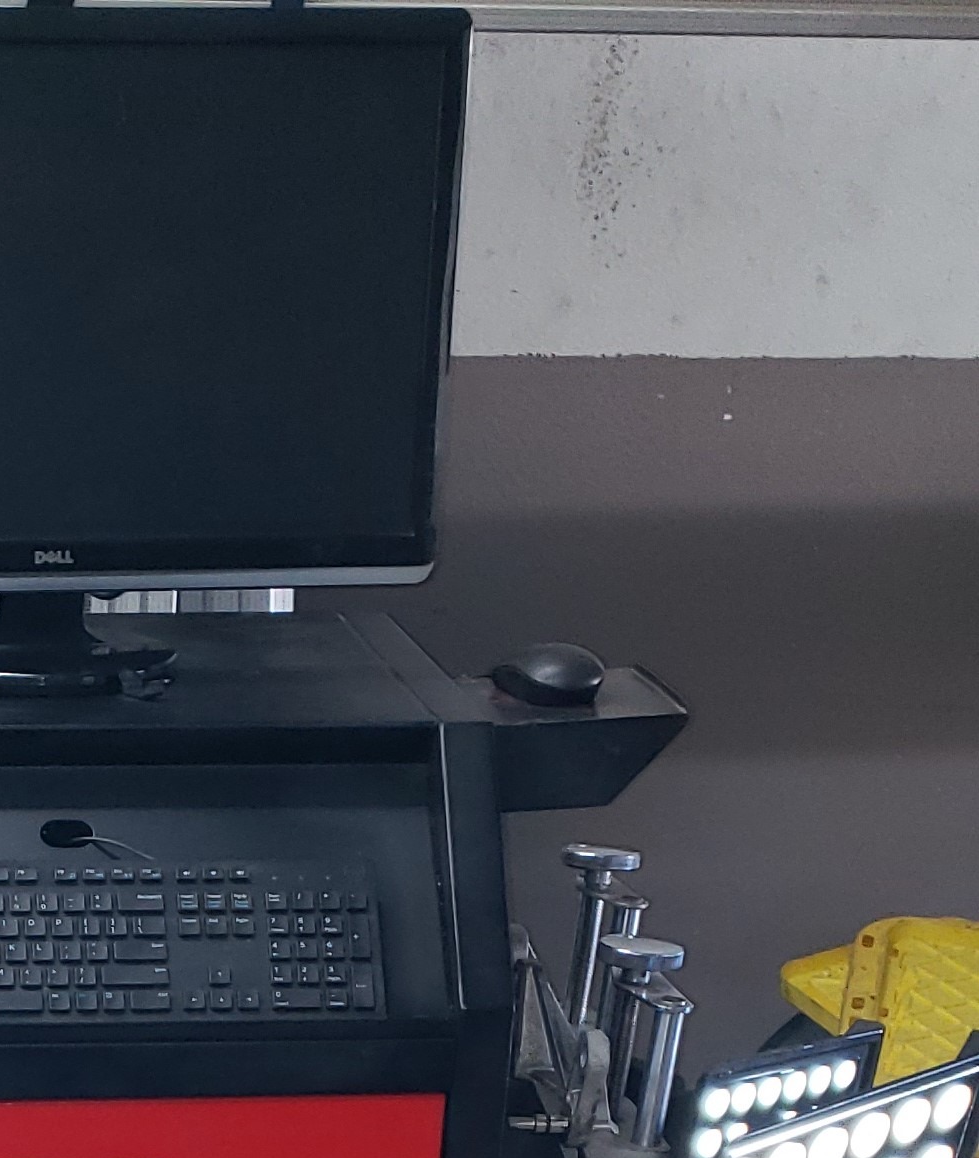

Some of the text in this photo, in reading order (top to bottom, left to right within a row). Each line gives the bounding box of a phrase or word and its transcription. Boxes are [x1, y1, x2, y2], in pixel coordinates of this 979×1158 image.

[34, 550, 75, 564] DELL
[55, 918, 62, 926] P
[80, 967, 84, 975] ?
